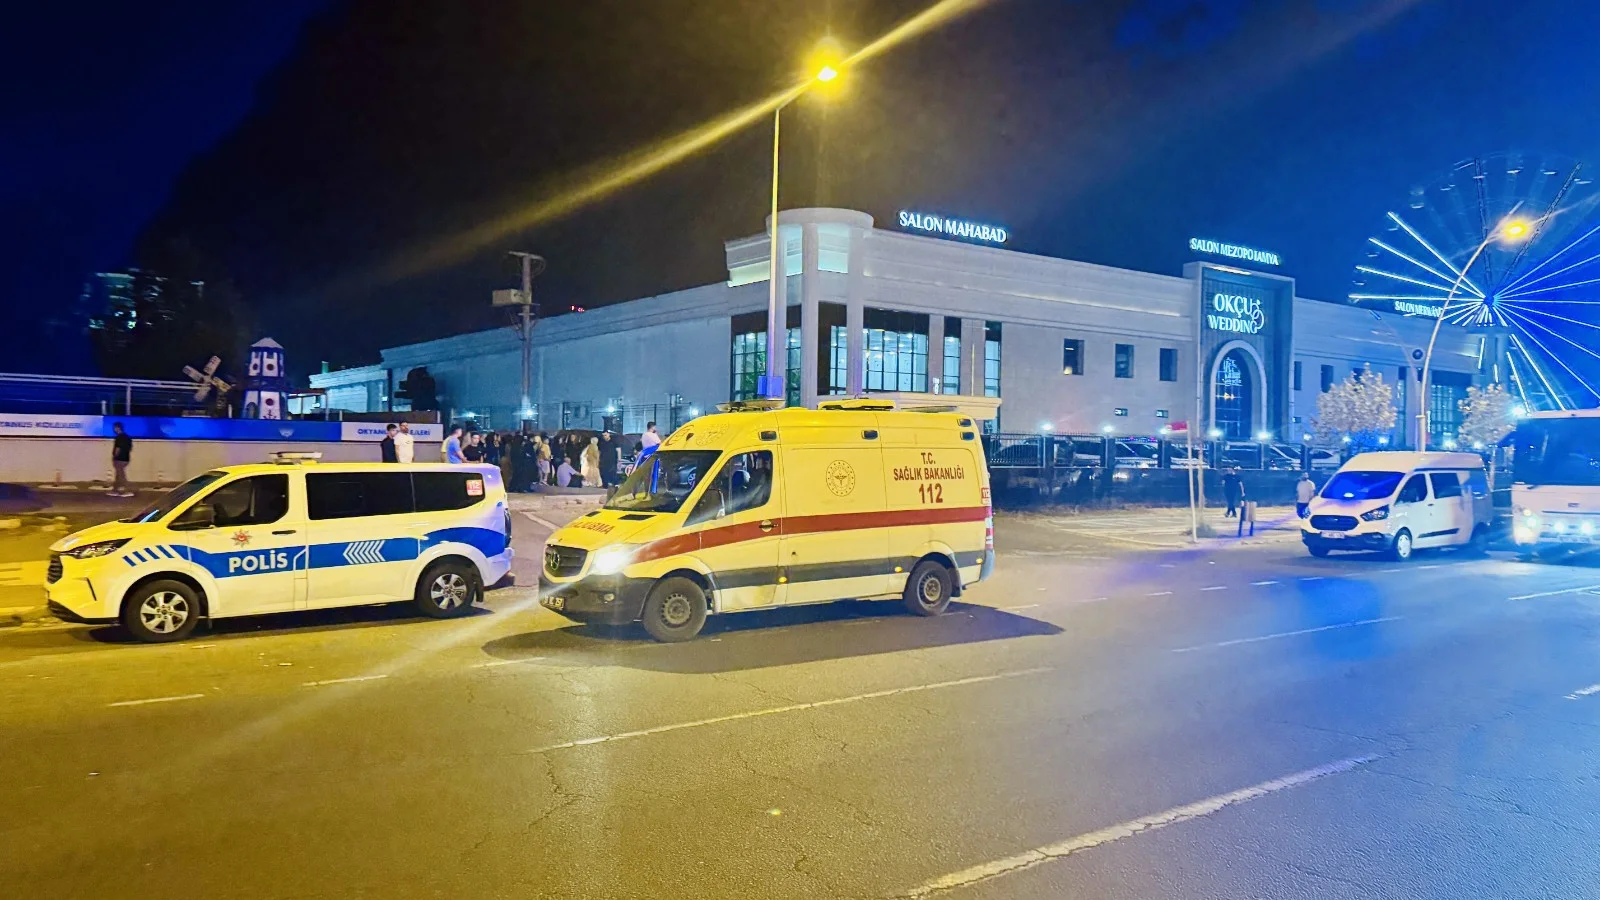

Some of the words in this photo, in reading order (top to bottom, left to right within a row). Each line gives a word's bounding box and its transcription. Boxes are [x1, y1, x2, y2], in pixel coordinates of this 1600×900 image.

[899, 211, 943, 233] SALON
[945, 219, 1007, 243] MAHABAD
[1190, 237, 1219, 254] SALON
[1214, 293, 1252, 318] OKÇU
[1395, 300, 1415, 313] SALON
[1207, 314, 1257, 334] WEDDING
[920, 452, 936, 465] T.C.
[893, 466, 922, 481] SAĞLIK
[924, 465, 965, 480] BAKANLIĞI
[919, 483, 943, 504] 112
[228, 549, 289, 573] POLİS
